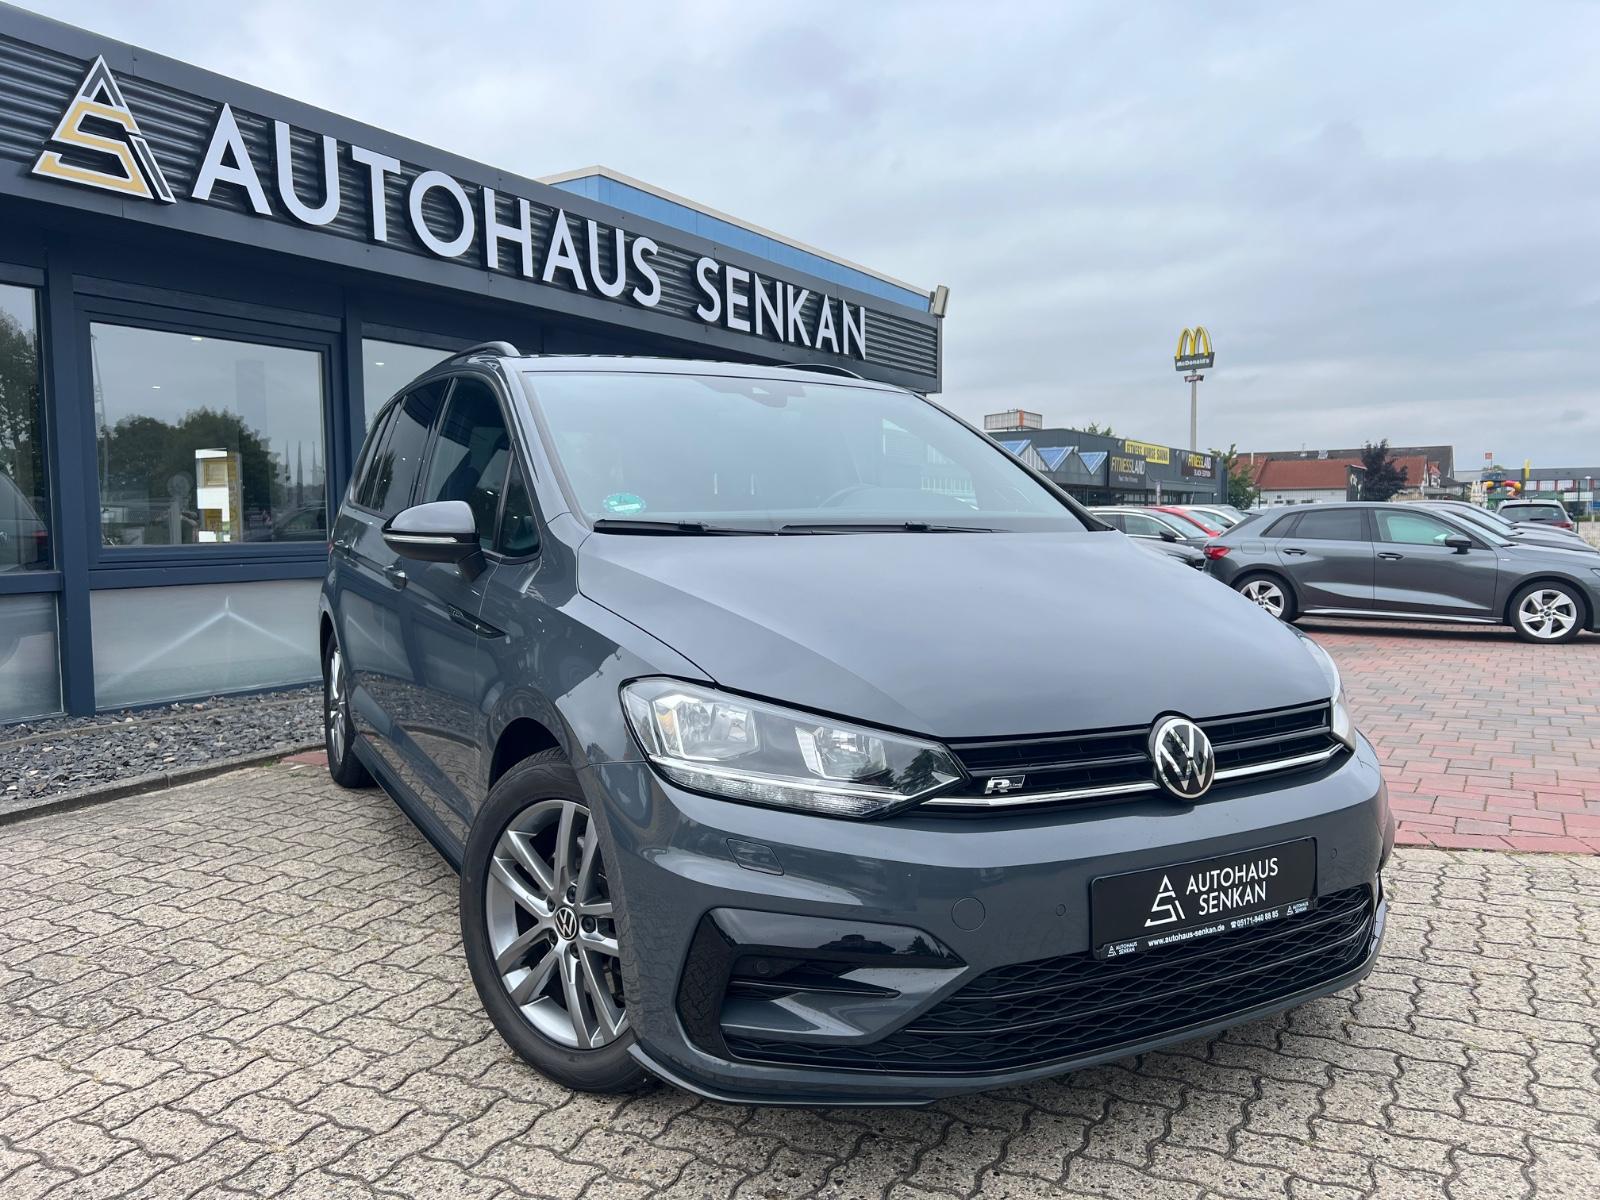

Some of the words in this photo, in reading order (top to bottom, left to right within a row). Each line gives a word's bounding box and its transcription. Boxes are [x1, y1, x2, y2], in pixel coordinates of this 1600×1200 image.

[192, 102, 661, 307] AUTOHAUS
[696, 257, 868, 360] SENKAN
[1186, 857, 1279, 895] AUTOHAUS
[1199, 881, 1266, 916] SENKAN
[1115, 941, 1138, 951] AUTOHAUS
[1148, 923, 1225, 947] www.autohaus-senkan.de
